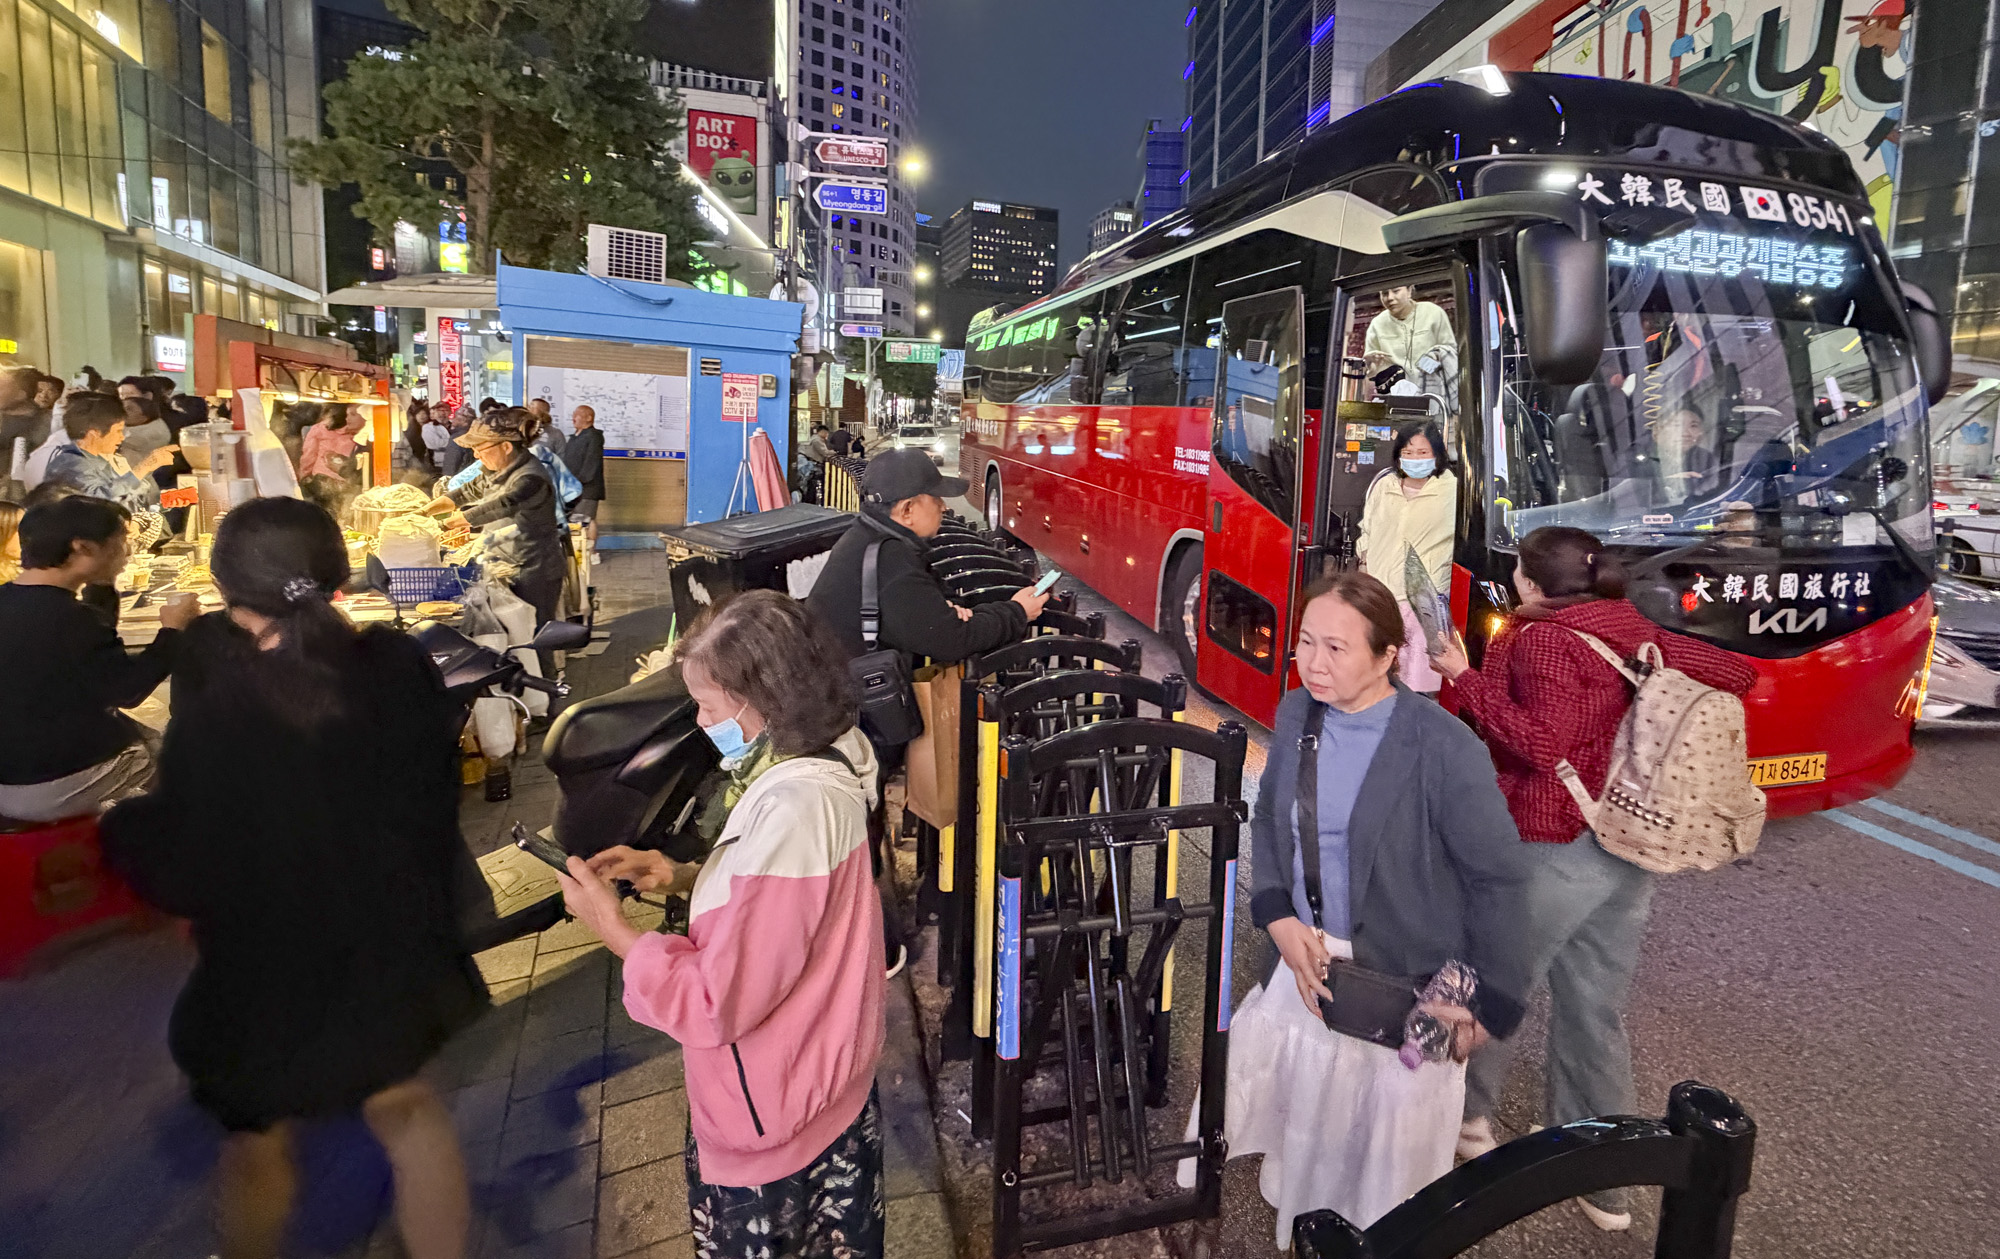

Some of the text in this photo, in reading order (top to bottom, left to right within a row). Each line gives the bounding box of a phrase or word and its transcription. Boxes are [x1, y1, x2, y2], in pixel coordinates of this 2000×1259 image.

[696, 117, 735, 134] ART
[851, 189, 882, 202] 명동길
[1578, 172, 1731, 215] 大韓民國
[823, 199, 883, 212] Myeongdong-gil
[1787, 192, 1854, 236] 8541
[1692, 571, 1871, 603] 大韓民國旅行社
[1780, 758, 1819, 780] 8541
